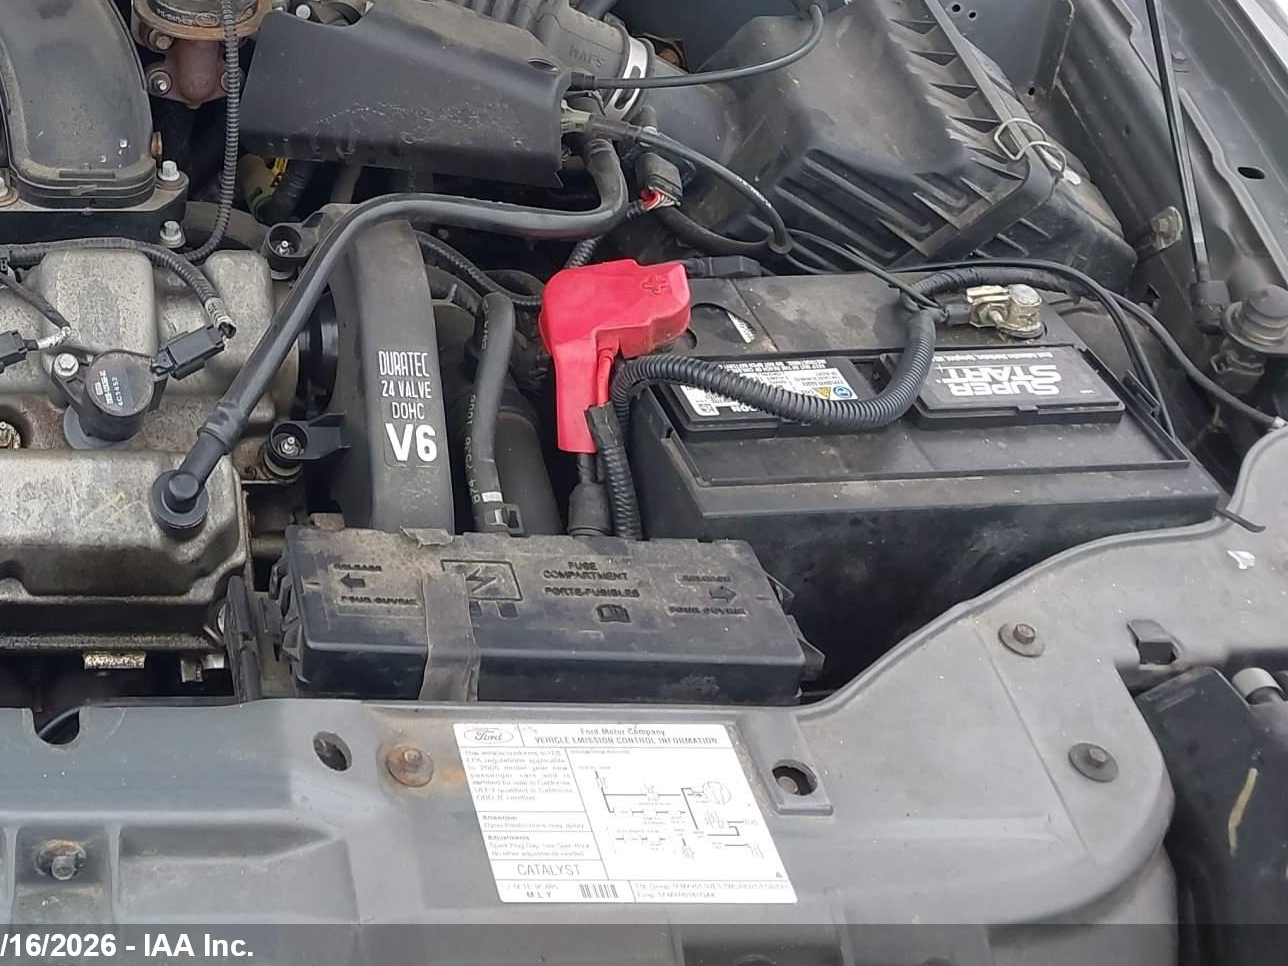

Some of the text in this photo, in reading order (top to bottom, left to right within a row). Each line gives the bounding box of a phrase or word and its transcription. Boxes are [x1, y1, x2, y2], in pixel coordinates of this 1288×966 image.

[378, 350, 430, 377] DURATEC
[942, 365, 1062, 383] START
[381, 380, 432, 399] 24 VALVE
[948, 381, 1060, 396] SUPER
[391, 401, 425, 420] DOHC
[385, 422, 438, 462] V6
[568, 561, 598, 571] FUSE
[543, 570, 628, 581] COMPARTMENT
[545, 587, 640, 598] PORTE-FUSIBLES
[474, 729, 503, 741] Ford
[627, 728, 665, 737] Company
[534, 736, 718, 745] VEHICLE EMISSION CONTROL INFORMATION
[517, 864, 581, 876] CATALYST
